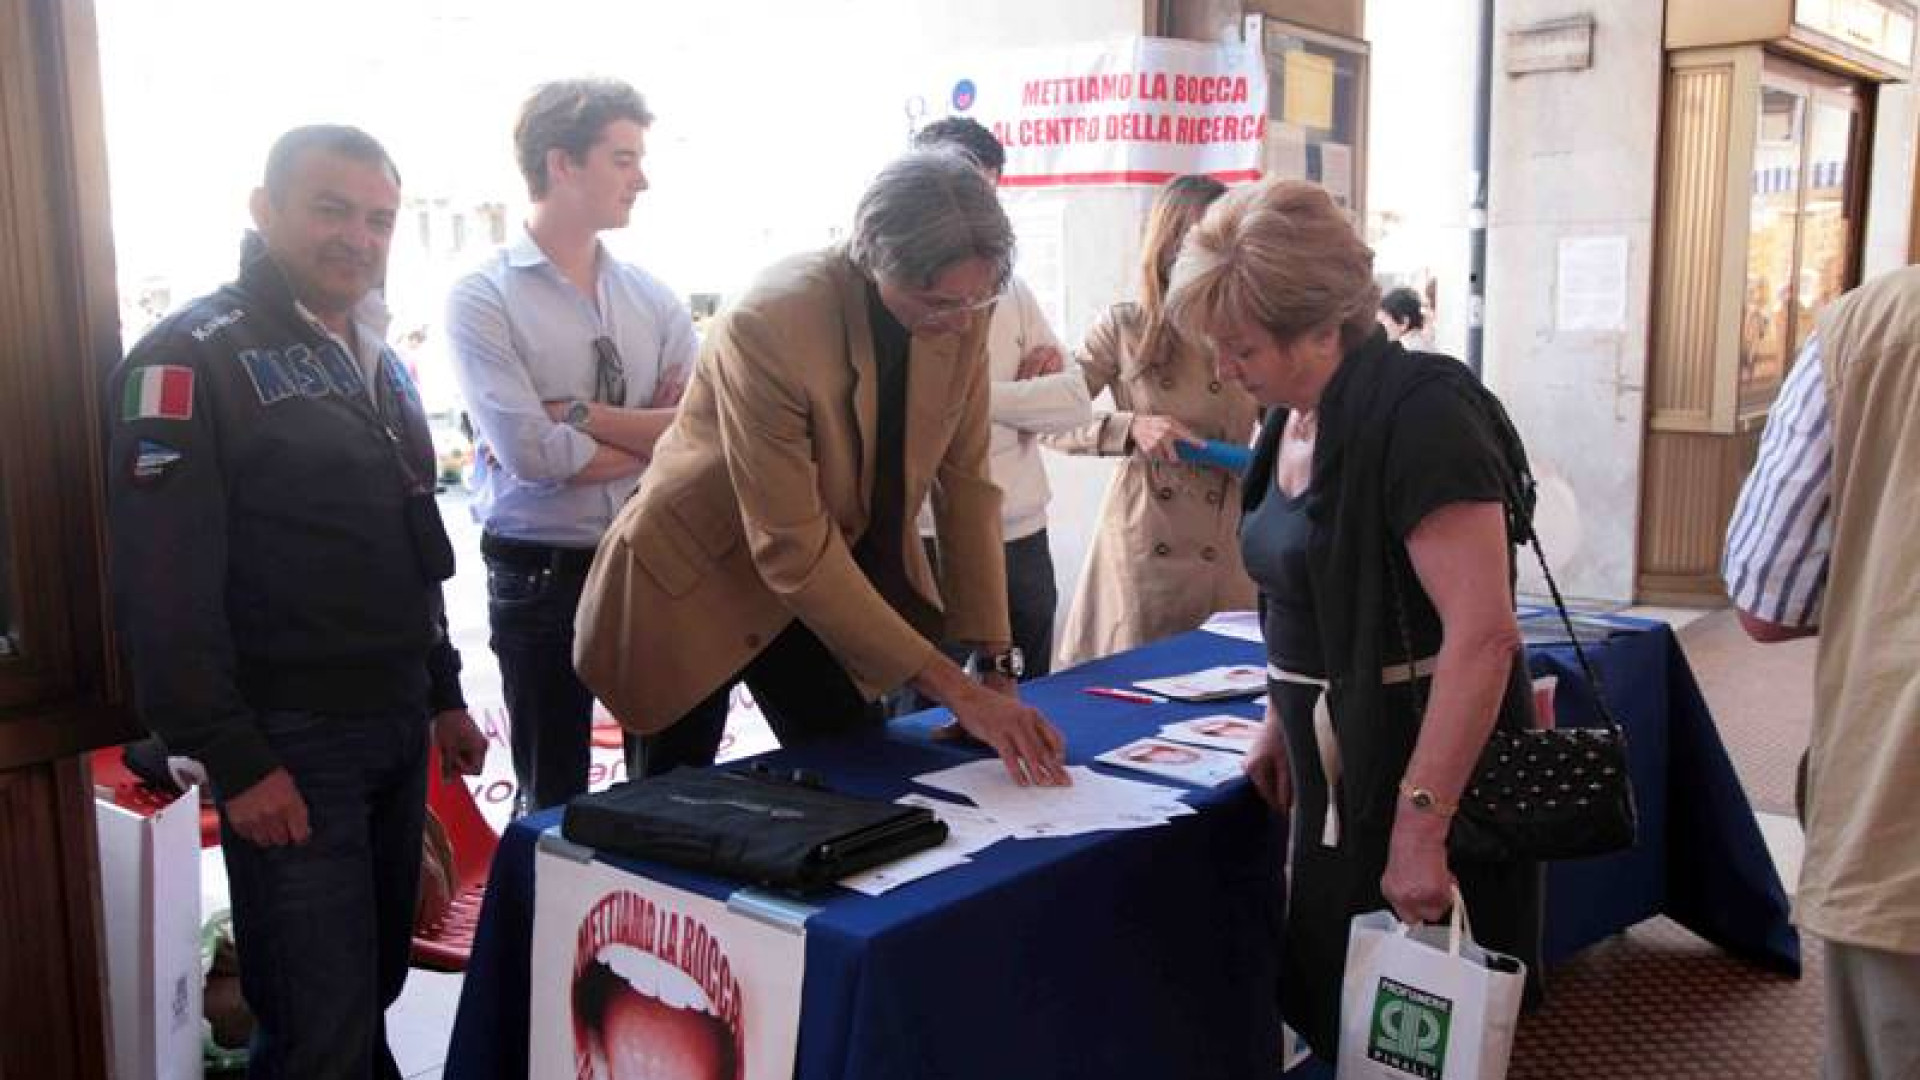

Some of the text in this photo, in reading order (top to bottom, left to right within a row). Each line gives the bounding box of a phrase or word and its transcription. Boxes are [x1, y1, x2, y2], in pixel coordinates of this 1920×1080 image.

[1021, 71, 1248, 107] METTIAMO LA BOCCA
[1018, 117, 1099, 147] CENTRO
[1105, 113, 1171, 143] DELLA
[659, 909, 679, 967] LA
